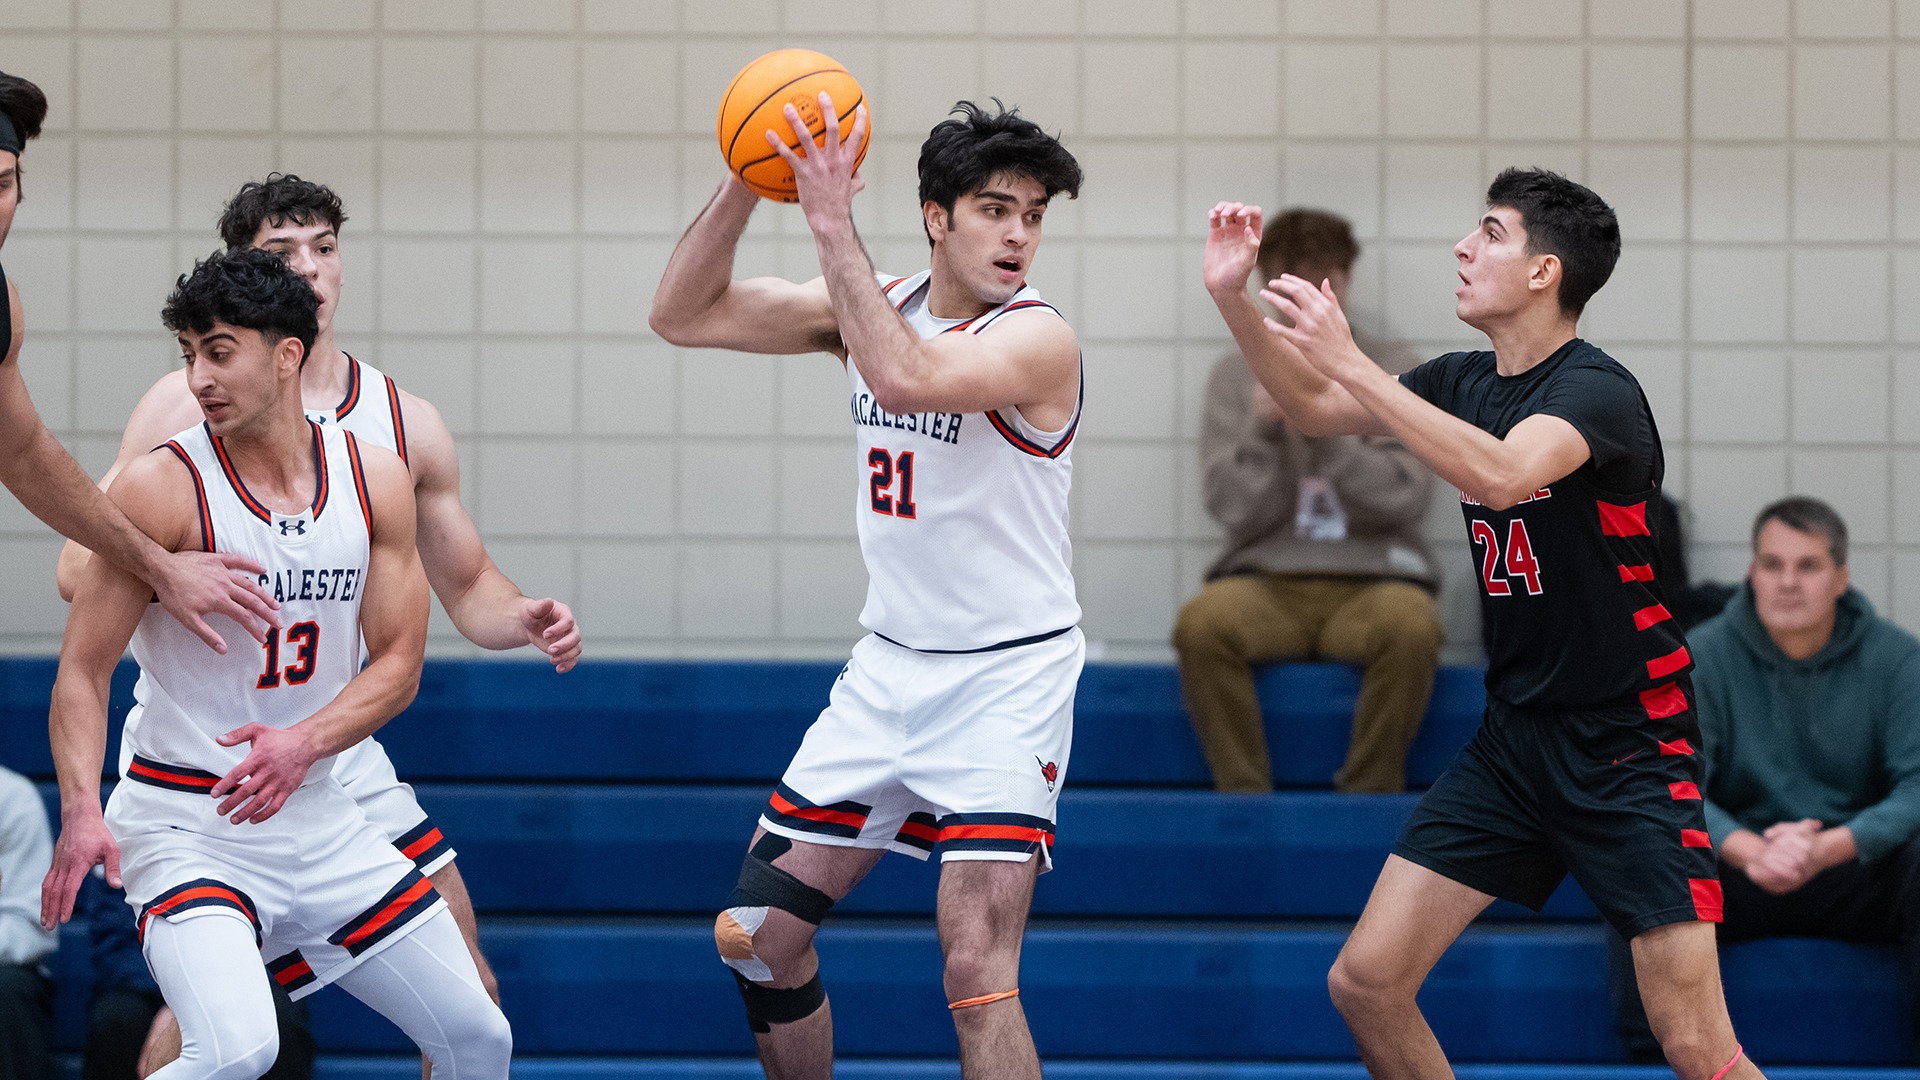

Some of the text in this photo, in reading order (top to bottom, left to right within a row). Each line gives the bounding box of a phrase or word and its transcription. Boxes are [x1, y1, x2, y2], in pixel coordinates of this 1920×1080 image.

[868, 447, 917, 520] 21
[1471, 518, 1544, 597] 24
[256, 620, 320, 689] 13
